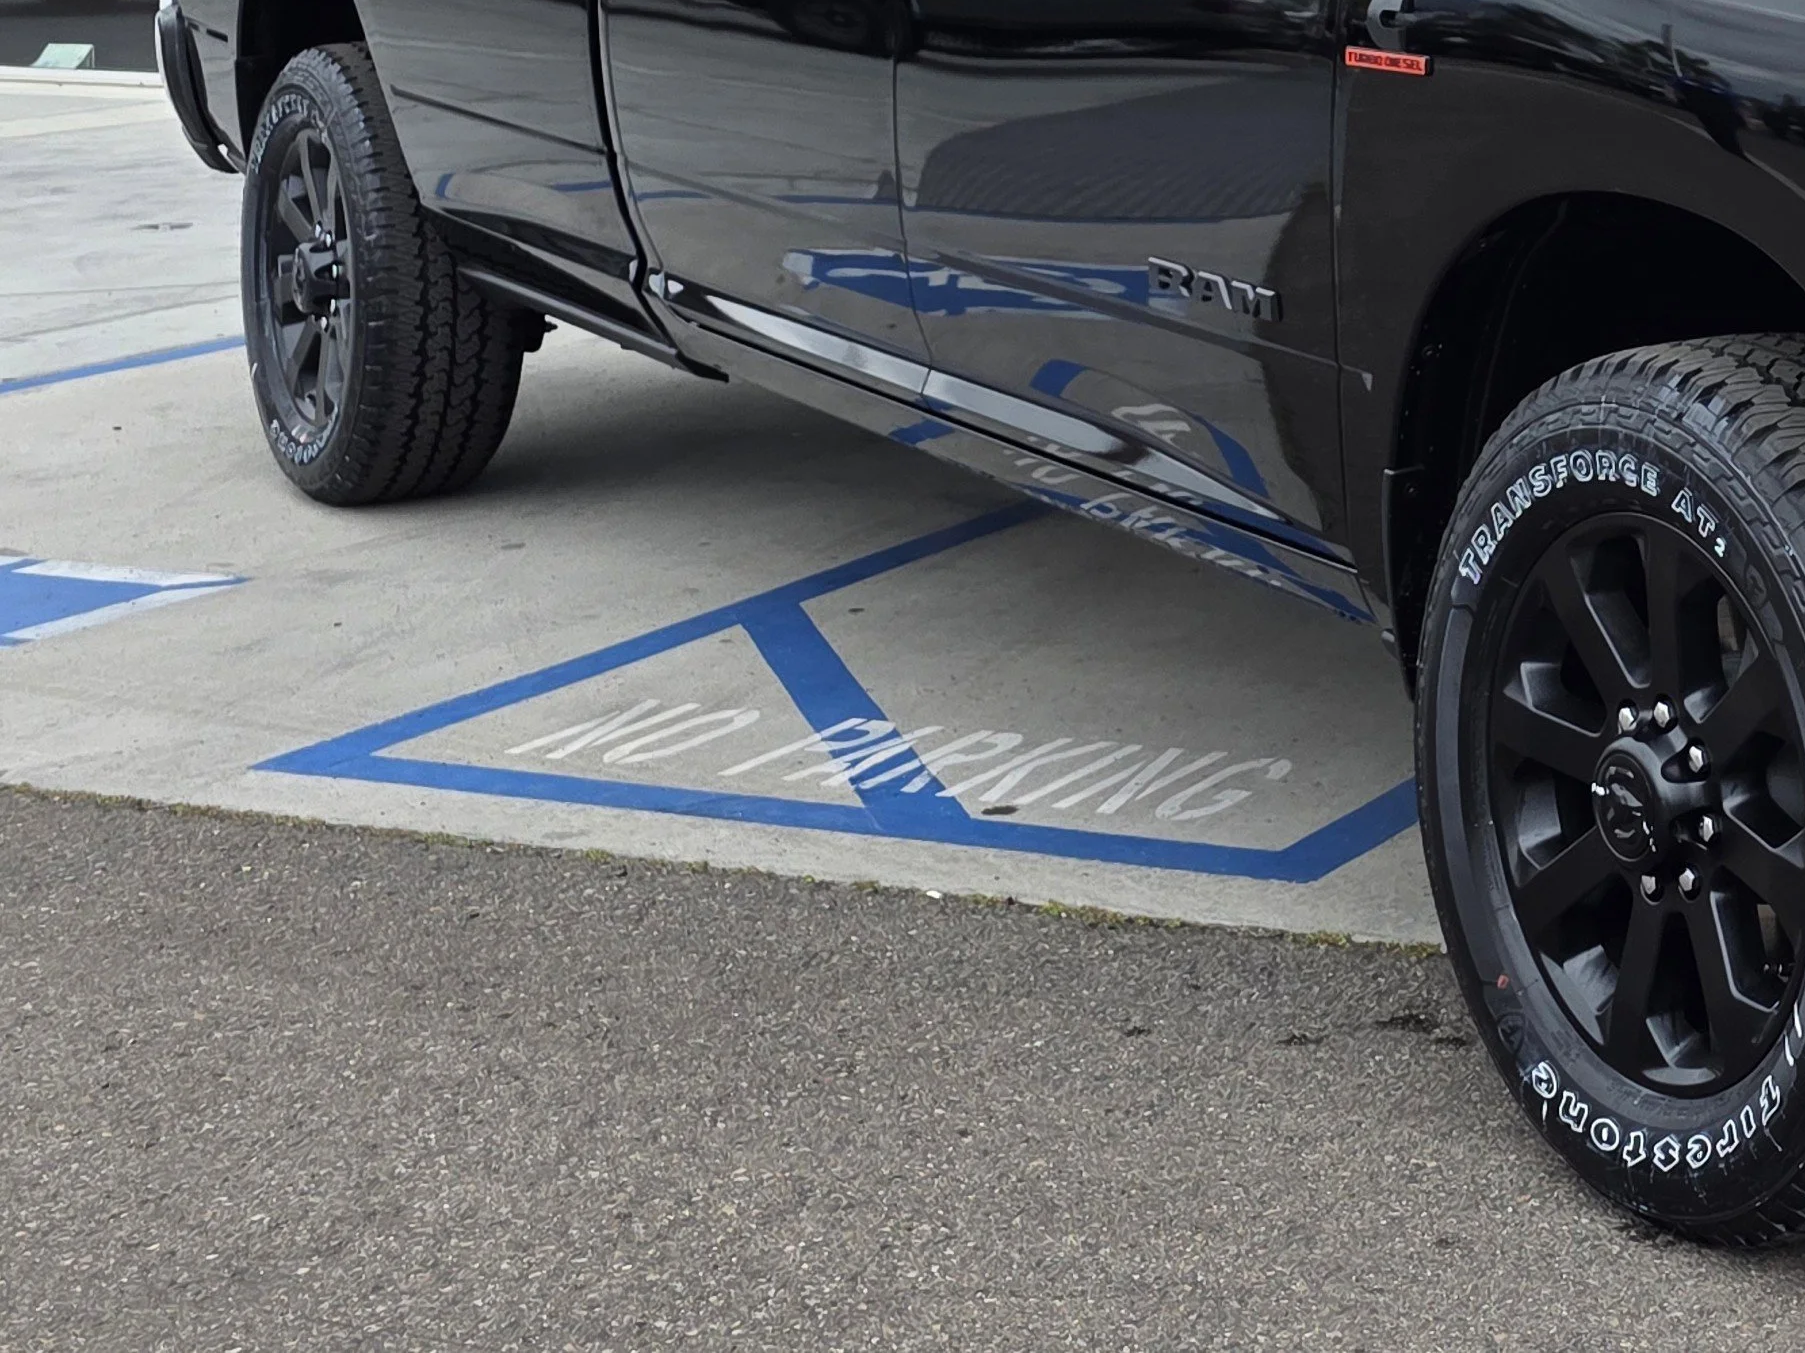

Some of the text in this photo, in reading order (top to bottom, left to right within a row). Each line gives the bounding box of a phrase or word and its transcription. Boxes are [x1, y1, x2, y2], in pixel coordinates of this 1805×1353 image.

[1148, 255, 1283, 322] RAM
[1458, 449, 1661, 585] TRANSFORCE
[504, 699, 1293, 821] NO PARKING
[1531, 1059, 1781, 1172] Firestone
